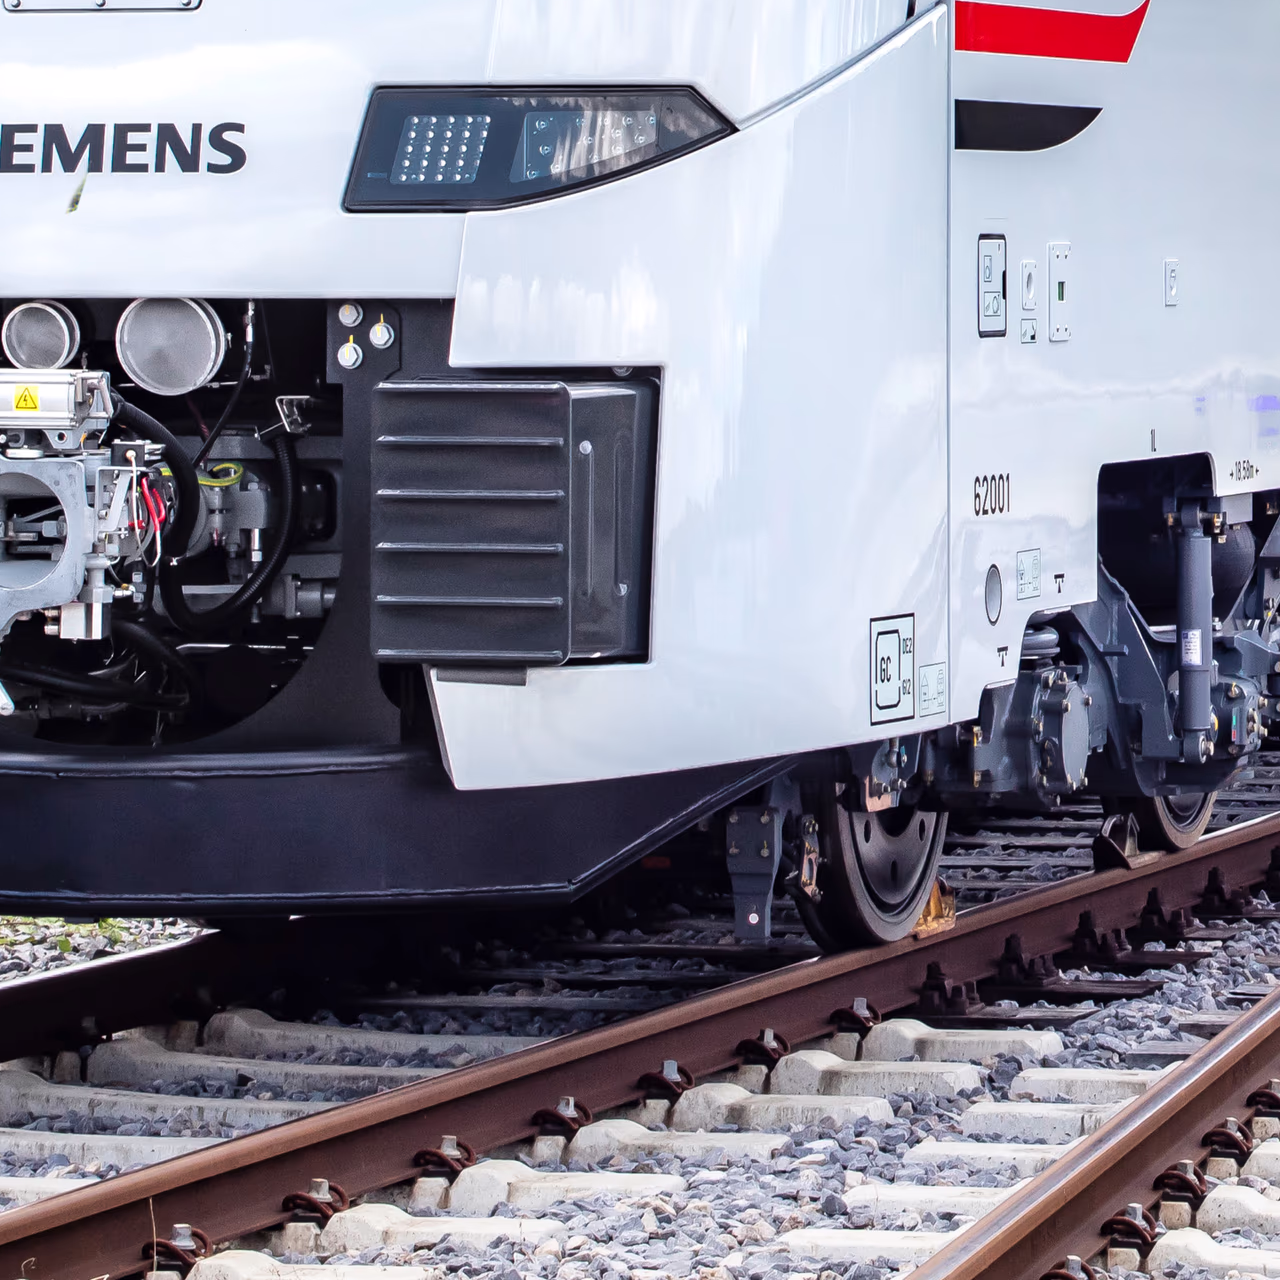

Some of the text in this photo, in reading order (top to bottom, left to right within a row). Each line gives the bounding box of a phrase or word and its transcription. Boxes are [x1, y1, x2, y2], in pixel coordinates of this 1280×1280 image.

[974, 473, 1010, 516] 62001
[902, 637, 912, 654] DE2
[880, 656, 891, 683] GC
